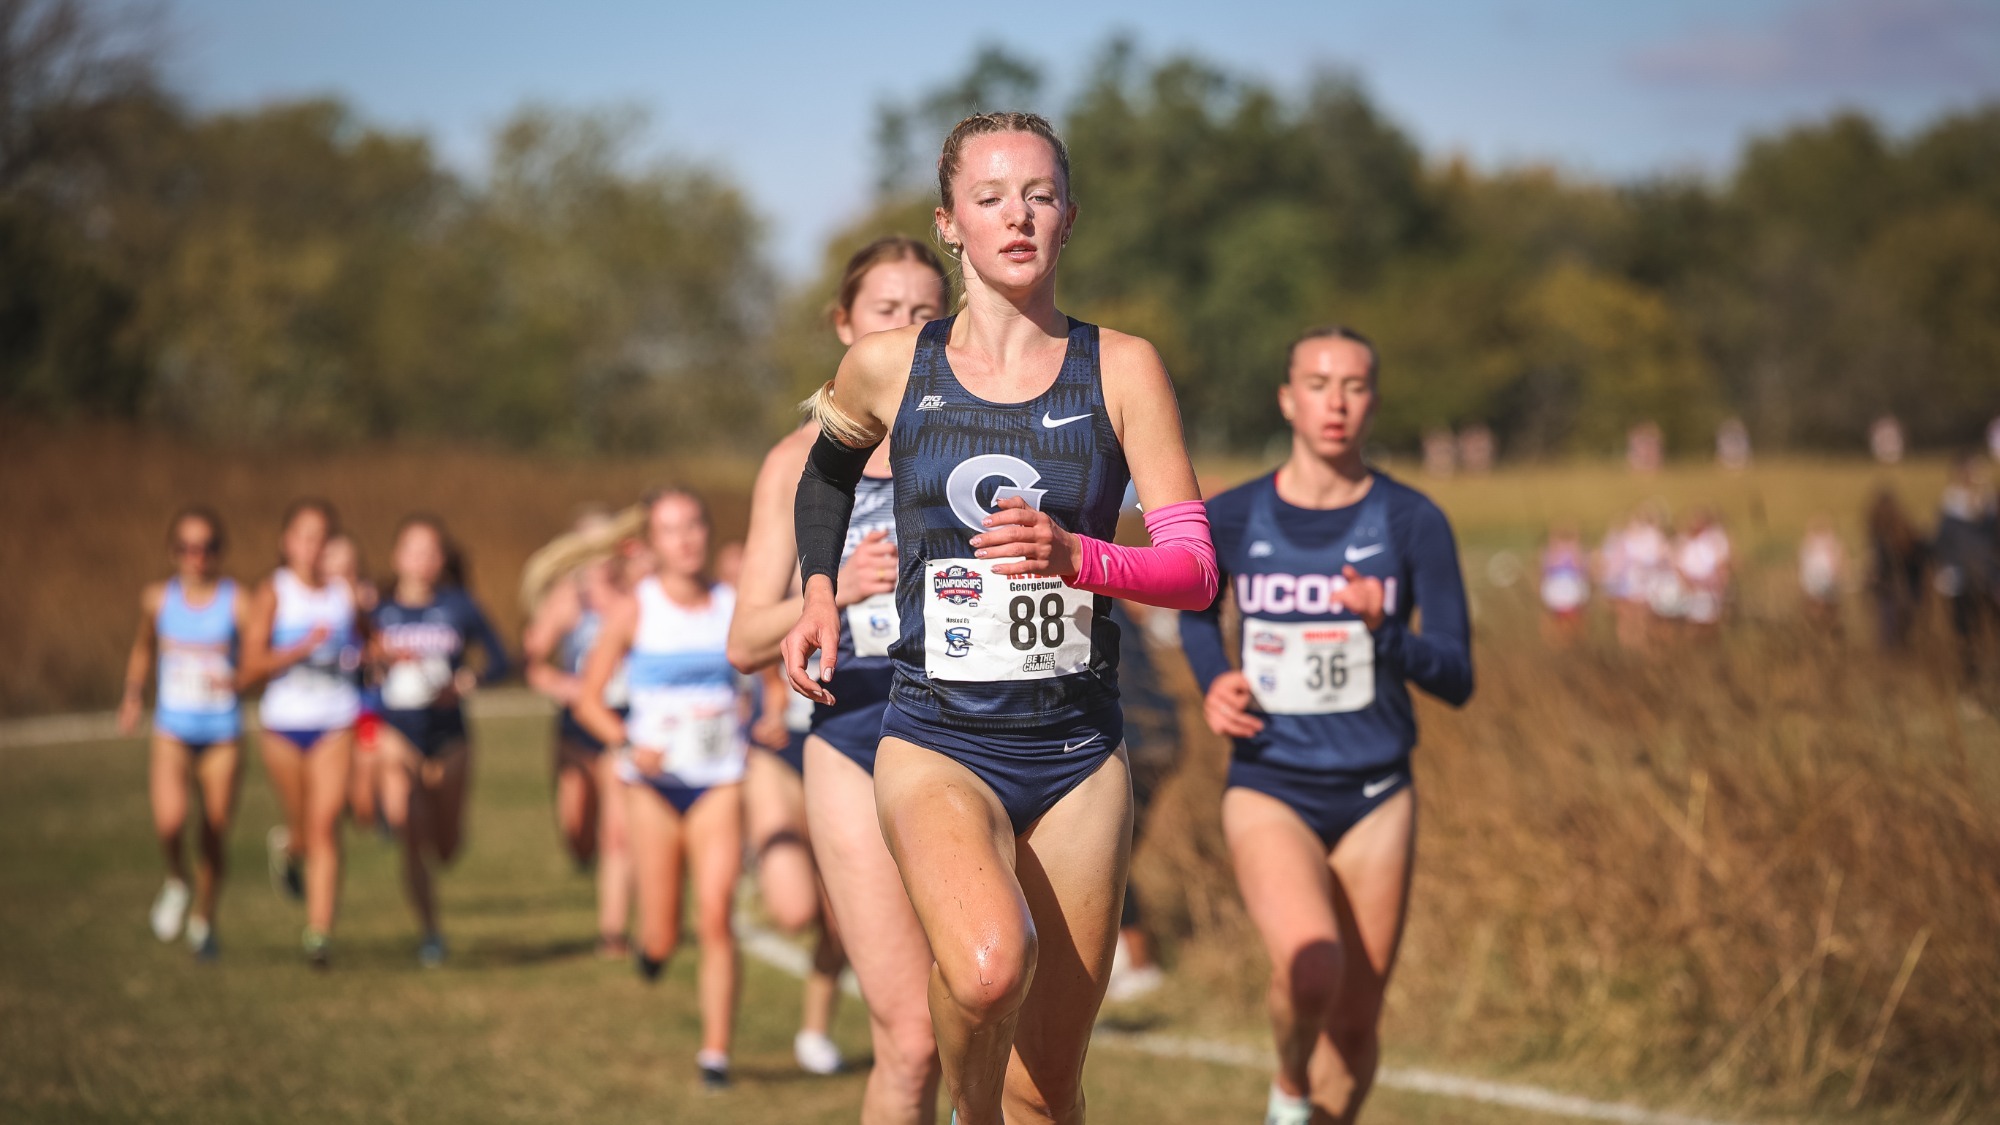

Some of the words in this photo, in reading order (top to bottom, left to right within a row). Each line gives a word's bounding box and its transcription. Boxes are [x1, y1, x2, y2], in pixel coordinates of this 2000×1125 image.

[946, 454, 1049, 534] G
[934, 578, 982, 590] CHAMPIONSHIPS
[1009, 580, 1062, 592] Georgetown
[1009, 593, 1065, 650] 88
[1026, 655, 1038, 664] BE
[1039, 653, 1054, 662] THE
[1023, 661, 1055, 672] CHANGE
[1305, 653, 1348, 691] 36
